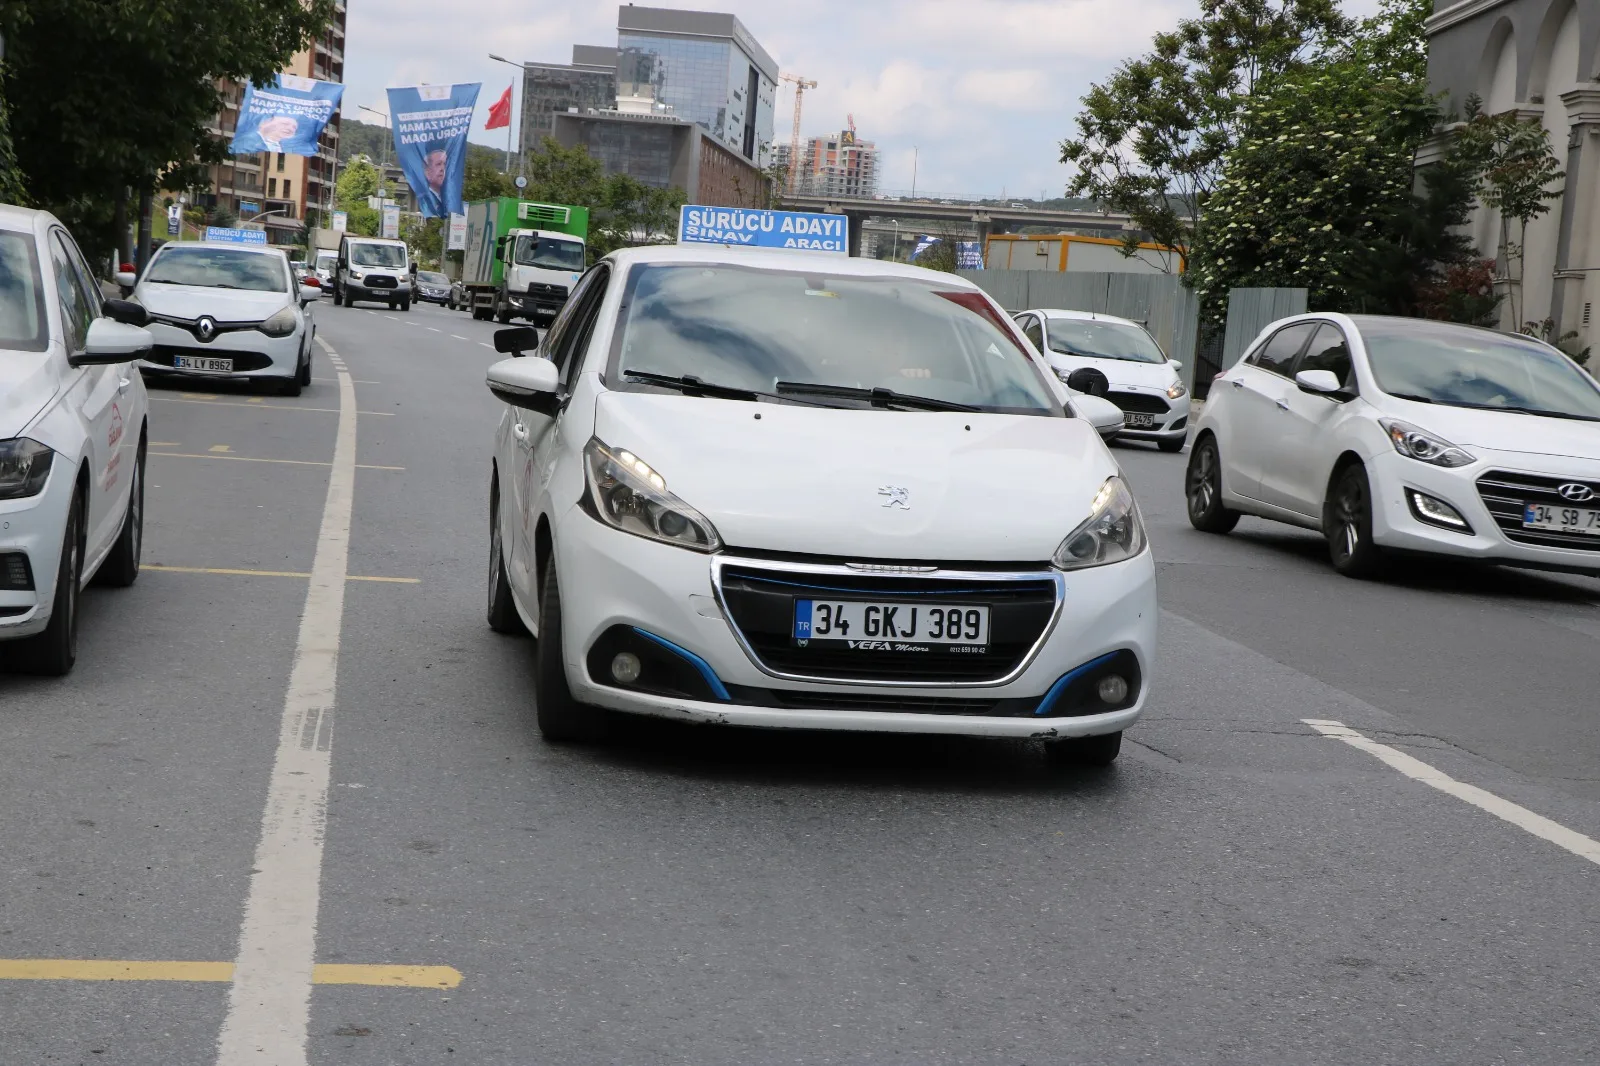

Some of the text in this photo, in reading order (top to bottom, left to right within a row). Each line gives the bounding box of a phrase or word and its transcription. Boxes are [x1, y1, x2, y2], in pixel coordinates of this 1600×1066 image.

[688, 208, 841, 236] SÜRÜCÜ ADAYI
[209, 228, 264, 240] SÜRÜCÜ ADAYI
[685, 226, 753, 243] SINAV
[784, 237, 841, 251] ARACI
[179, 357, 191, 368] 34
[209, 359, 231, 371] 8962
[1134, 415, 1152, 424] 5475
[1536, 506, 1553, 523] 34
[1561, 509, 1579, 526] SB
[797, 621, 810, 631] TR
[815, 603, 981, 640] 34 GKJ 389
[847, 640, 929, 652] VEFA Motors
